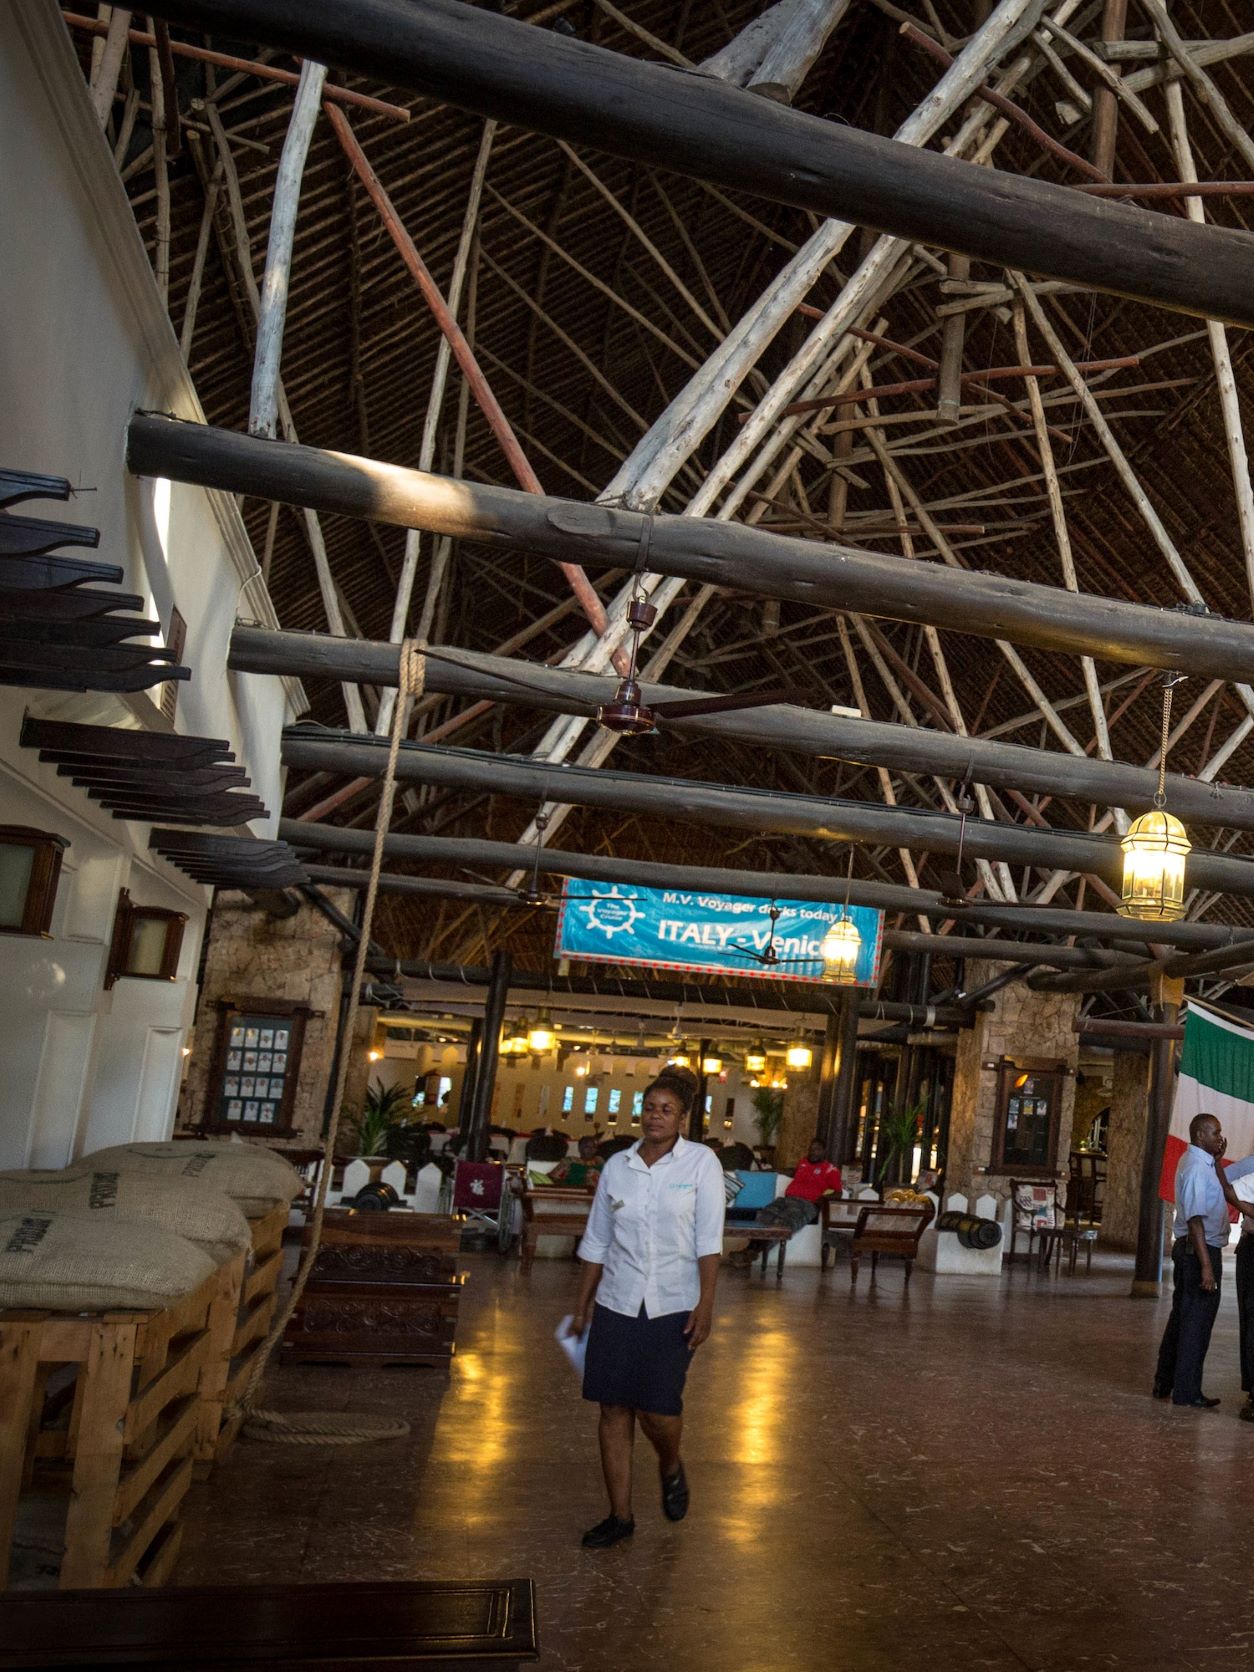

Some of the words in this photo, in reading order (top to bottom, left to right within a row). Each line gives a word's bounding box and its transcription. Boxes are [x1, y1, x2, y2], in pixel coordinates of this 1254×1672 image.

[663, 892, 694, 906] M.V.
[698, 896, 756, 914] Voyager
[800, 909, 838, 923] today
[658, 919, 733, 947] ITALY
[752, 929, 826, 957] Venic
